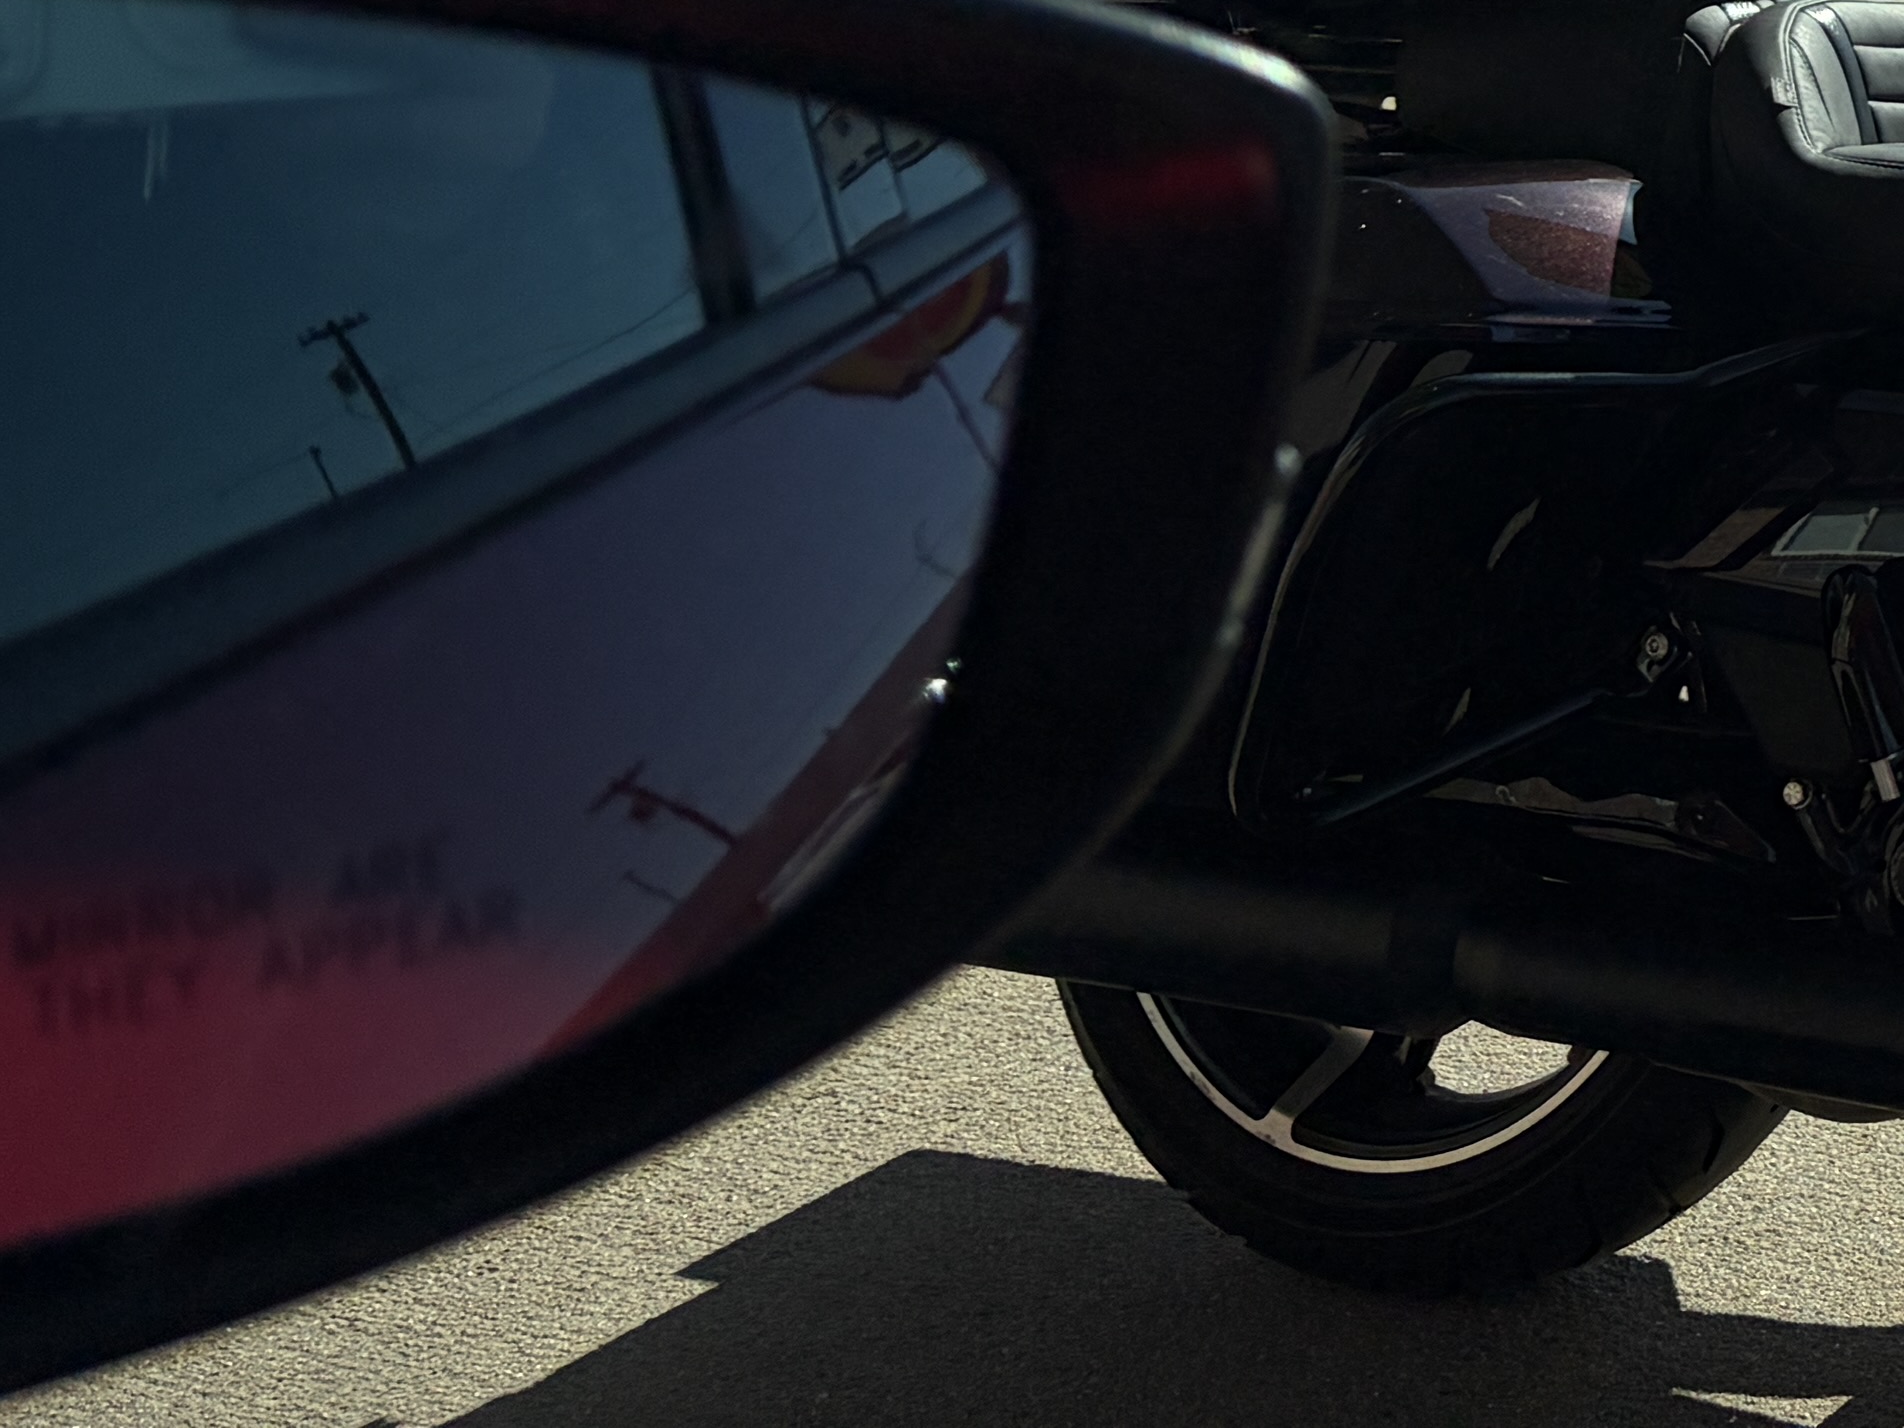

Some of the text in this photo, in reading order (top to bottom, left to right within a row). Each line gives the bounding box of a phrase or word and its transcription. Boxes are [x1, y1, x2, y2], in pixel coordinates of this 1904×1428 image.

[331, 826, 451, 905] ARE
[33, 883, 525, 1039] THEY APPEAR
